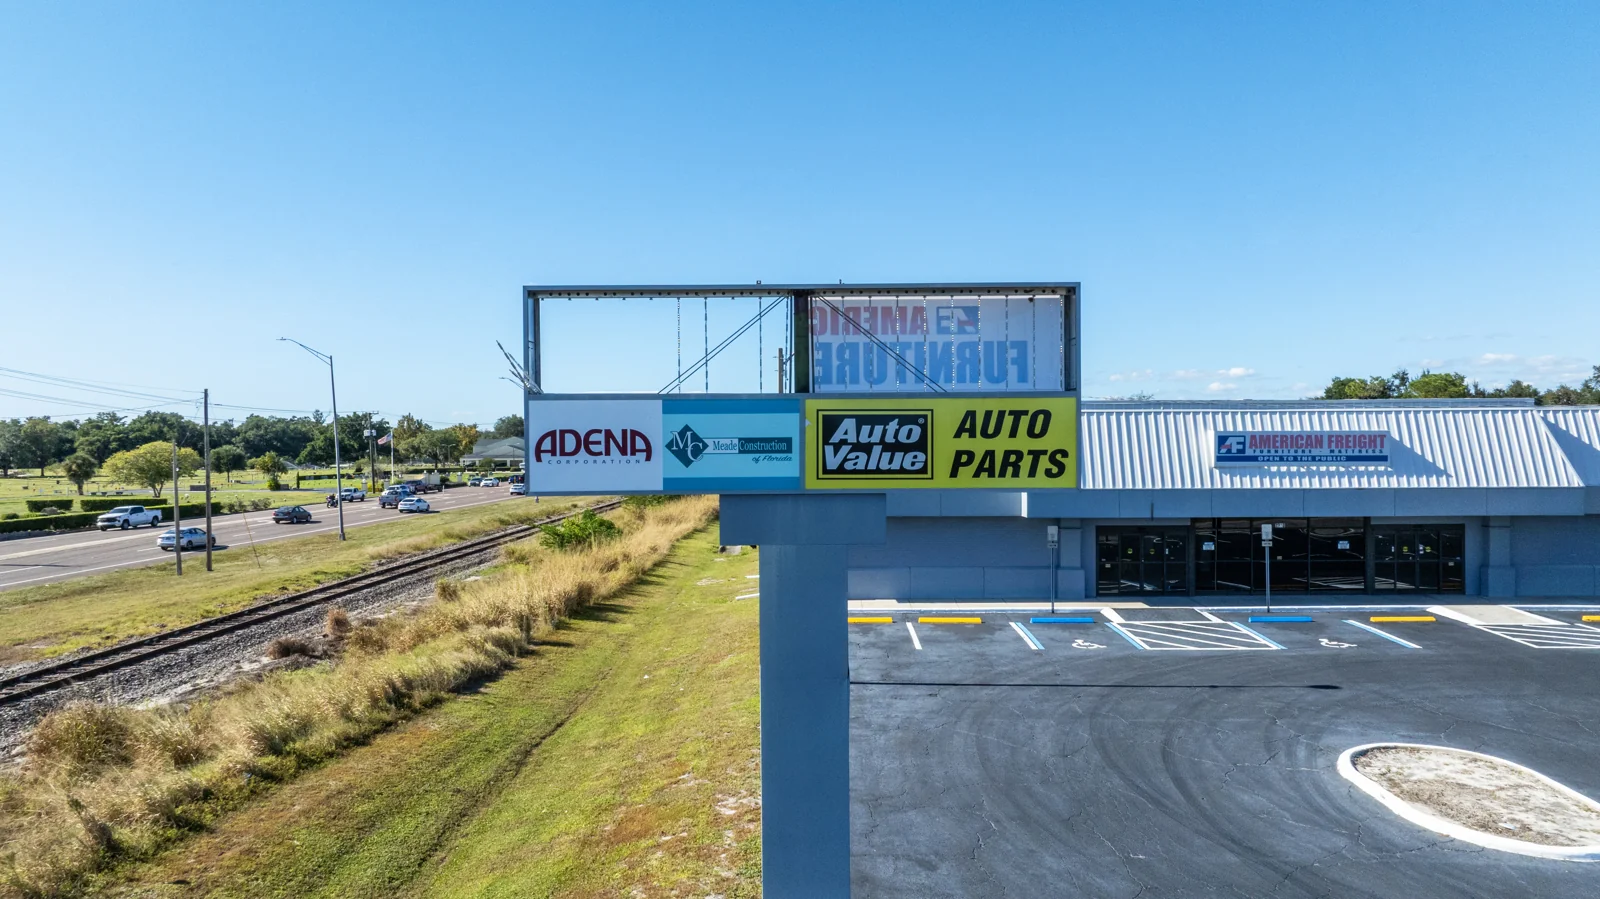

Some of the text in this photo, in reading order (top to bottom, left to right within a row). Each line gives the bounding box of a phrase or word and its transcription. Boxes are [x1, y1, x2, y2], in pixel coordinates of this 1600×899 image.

[829, 418, 922, 443] Auto
[953, 409, 1052, 439] AUTO
[535, 428, 653, 463] ADENA
[712, 439, 787, 451] Meade Construction
[1249, 434, 1324, 449] AMERICAN
[1327, 434, 1387, 449] FREIGHT
[752, 455, 761, 464] of
[824, 445, 926, 470] Value
[949, 448, 1069, 479] PARTS
